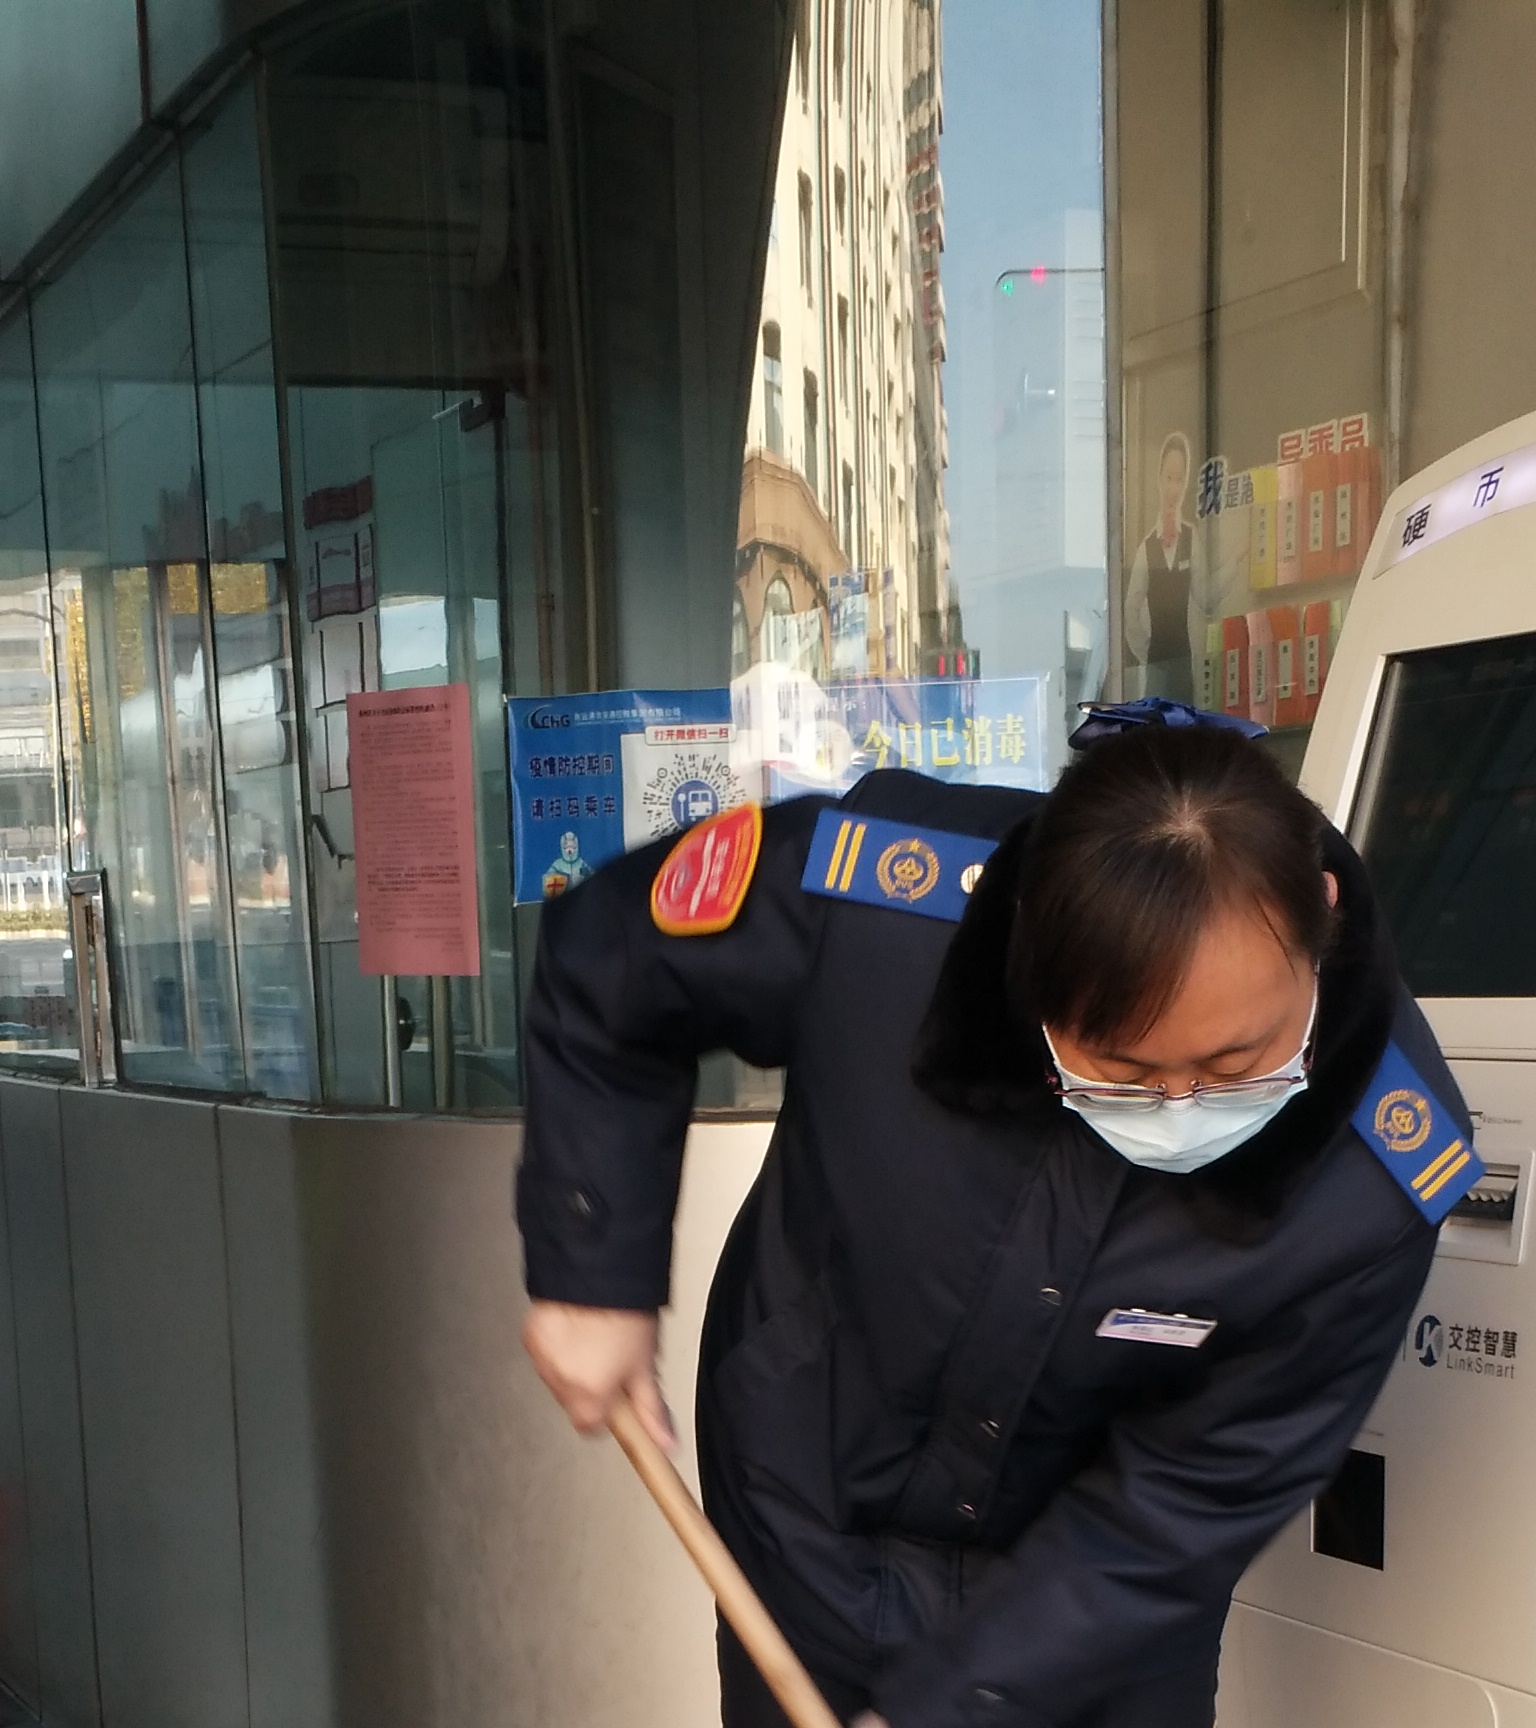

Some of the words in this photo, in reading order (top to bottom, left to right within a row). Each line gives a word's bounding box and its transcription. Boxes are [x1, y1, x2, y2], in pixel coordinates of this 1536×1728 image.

[654, 727, 729, 741] 打开微信扫一扫
[863, 713, 1027, 769] 今日已消毒
[529, 754, 615, 778] 疫情防控期间
[531, 796, 616, 820] 请扫码乘车
[1448, 1323, 1519, 1359] 交控智慧
[1446, 1353, 1515, 1380] LinkSmart
